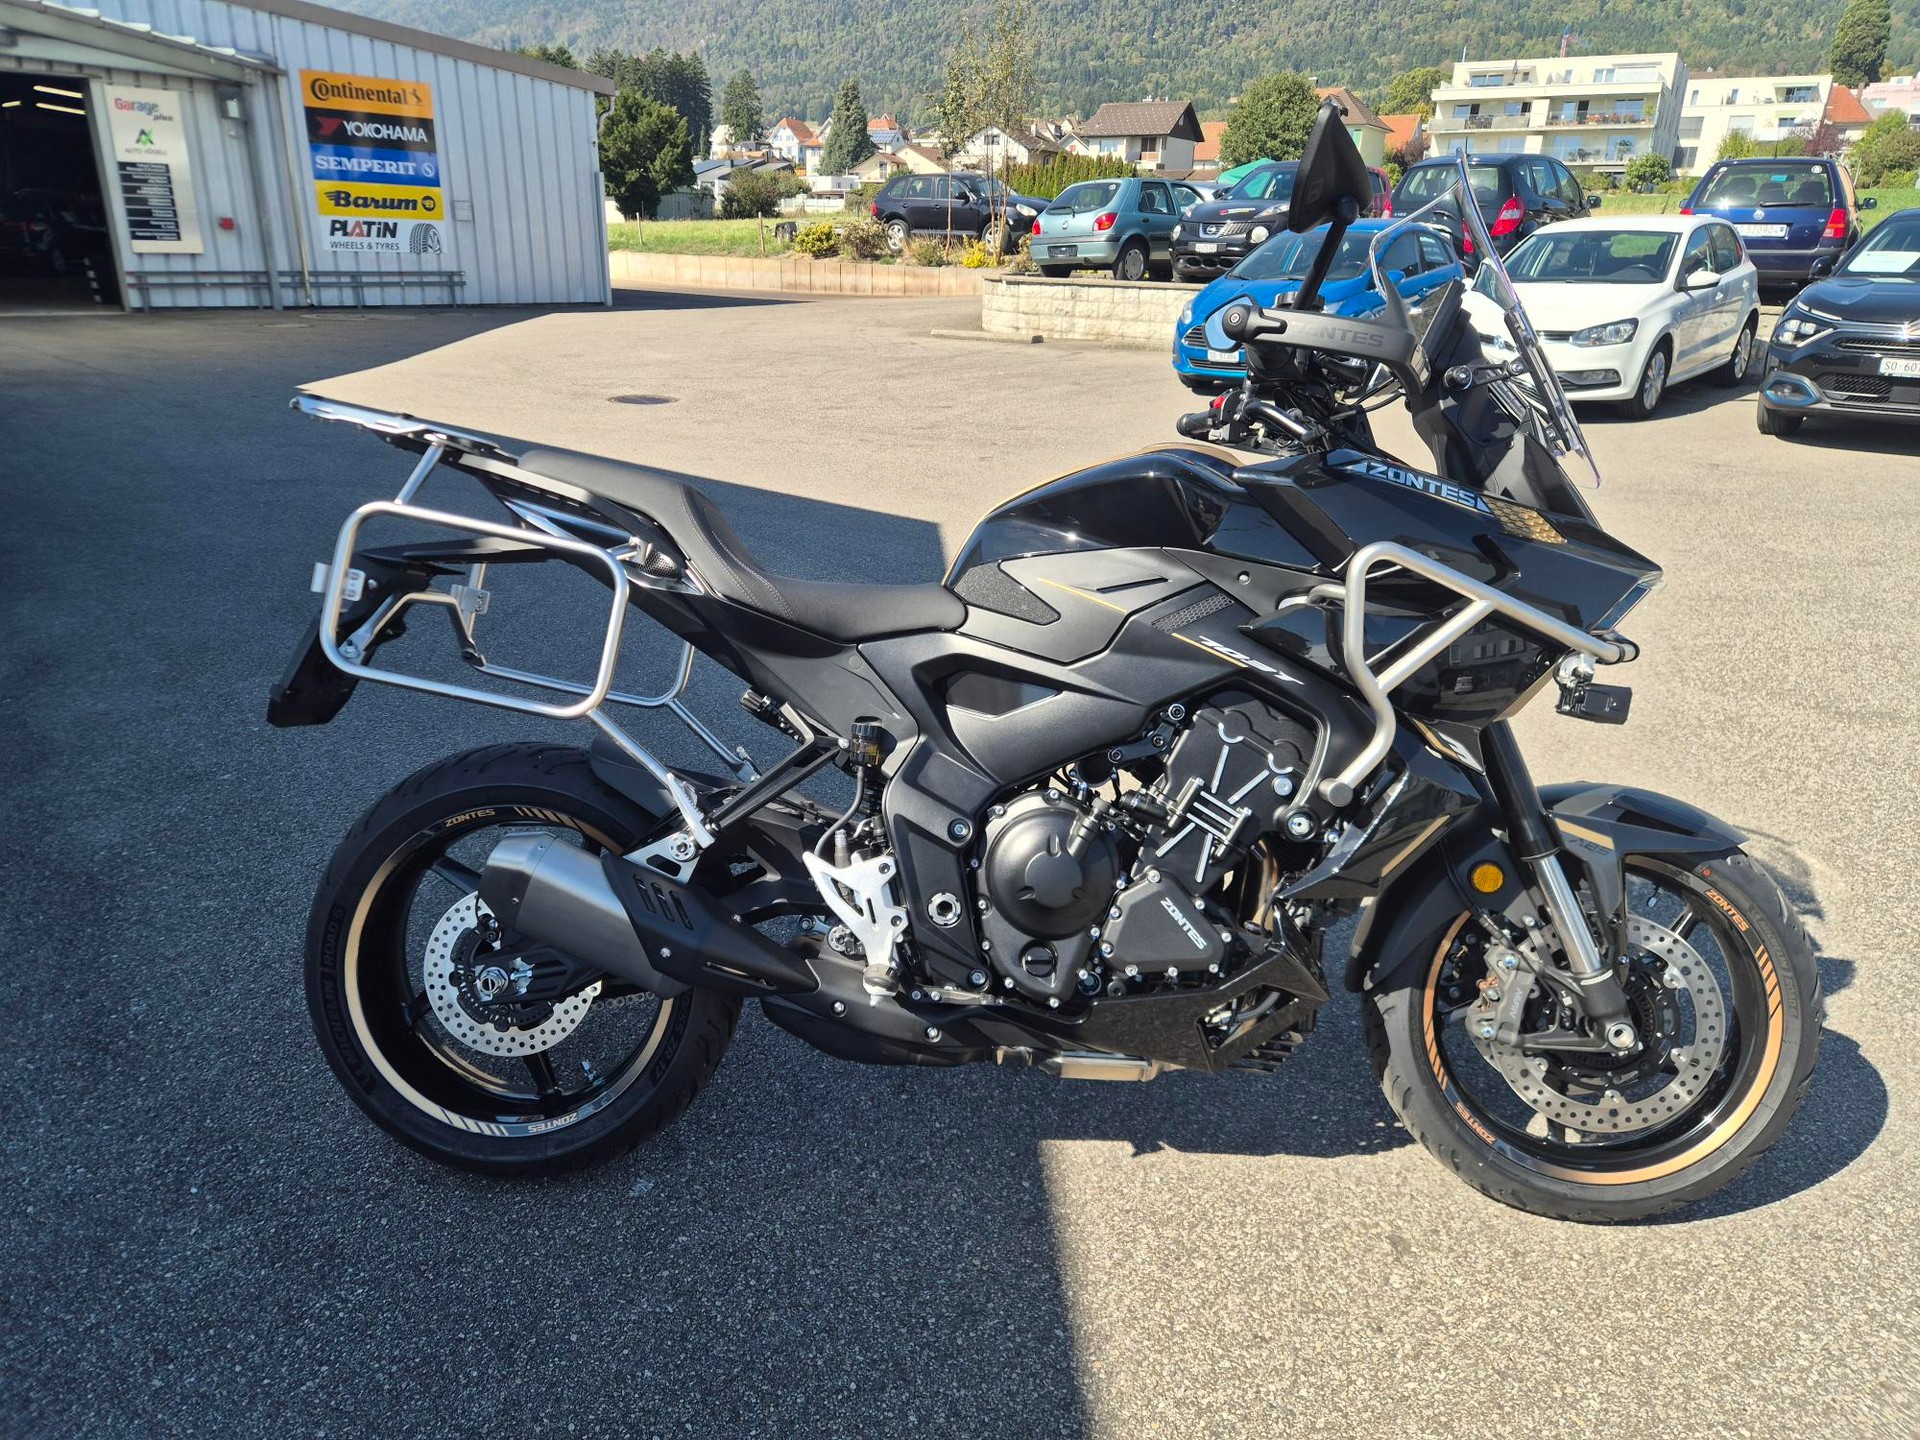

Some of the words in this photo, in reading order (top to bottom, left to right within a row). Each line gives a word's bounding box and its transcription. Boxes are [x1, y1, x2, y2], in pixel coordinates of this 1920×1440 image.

[310, 78, 409, 106] Continental
[114, 97, 159, 116] Garage
[343, 120, 428, 143] YOKOHAMA
[315, 155, 417, 176] SEMPERIT
[323, 190, 418, 212] Barum
[330, 240, 364, 250] WHEELS
[367, 242, 373, 250] &
[375, 241, 400, 251] TYRES
[1885, 361, 1898, 371] SO
[1903, 362, 1920, 373] 60
[1365, 461, 1476, 508] ZONTES
[444, 808, 496, 828] ZONTES
[1705, 888, 1750, 933] ZONTES
[1160, 897, 1208, 951] ZONTES
[322, 920, 339, 968] ROAD
[527, 1112, 578, 1133] ZONTES
[1455, 1101, 1496, 1145] ZONTES
